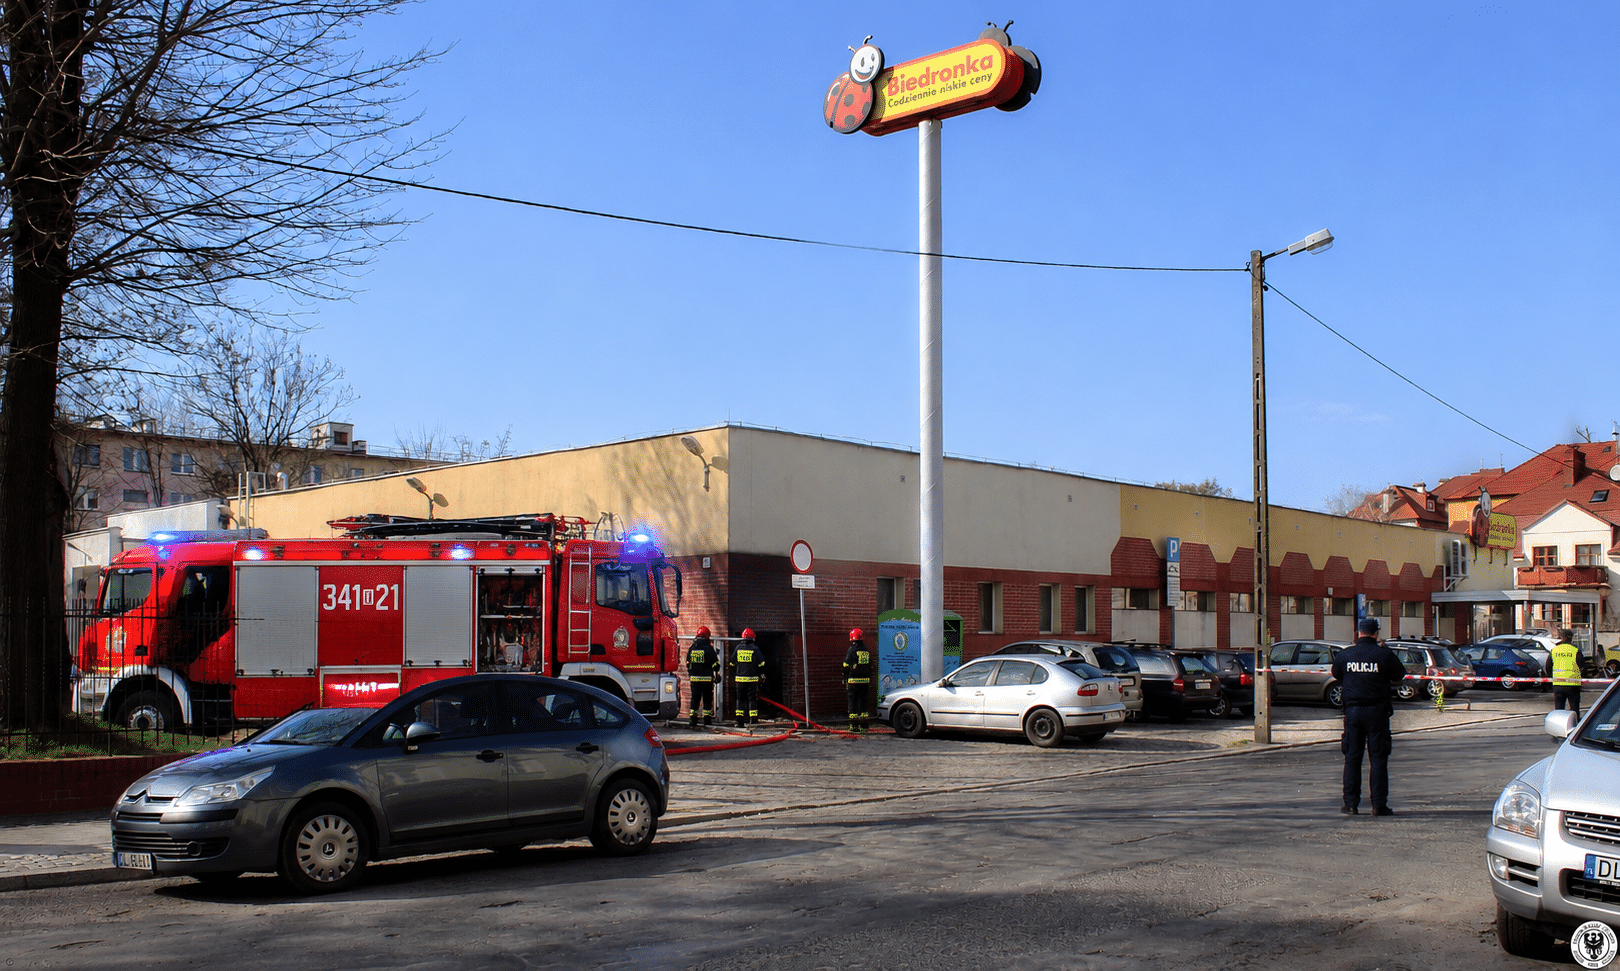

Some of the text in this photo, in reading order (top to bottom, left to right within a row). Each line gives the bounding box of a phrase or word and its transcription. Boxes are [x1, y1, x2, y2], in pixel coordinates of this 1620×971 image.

[887, 54, 994, 97] Biedronka
[887, 72, 993, 108] Codziennie niskie ceny
[1170, 539, 1178, 558] P
[1346, 661, 1379, 673] POLICJA
